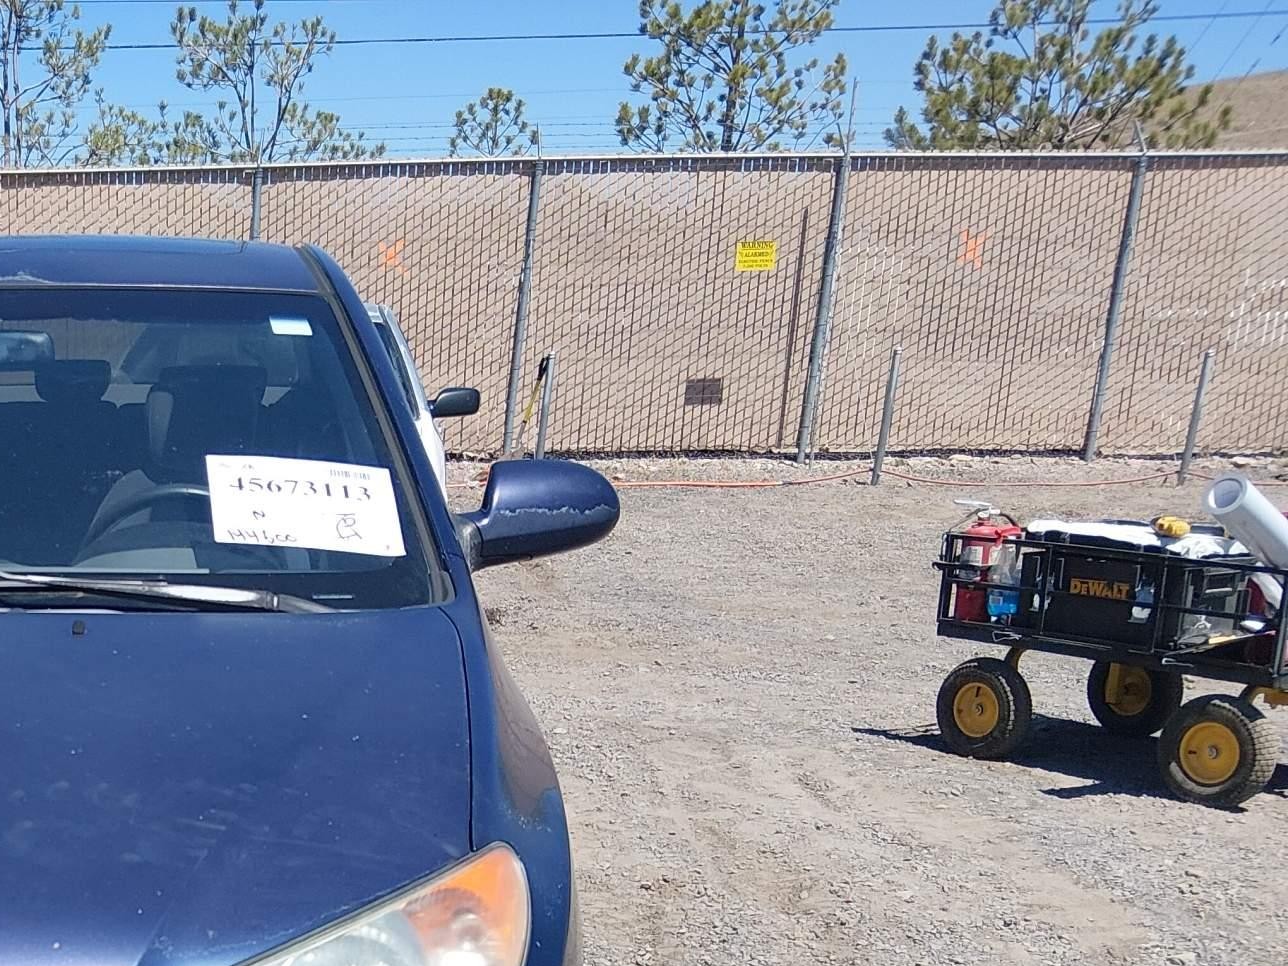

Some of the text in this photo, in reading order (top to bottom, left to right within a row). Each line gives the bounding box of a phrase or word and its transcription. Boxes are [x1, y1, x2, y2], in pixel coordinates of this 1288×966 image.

[741, 241, 774, 249] WARNING
[229, 476, 371, 501] 45673113
[1069, 578, 1130, 600] DEWALT
